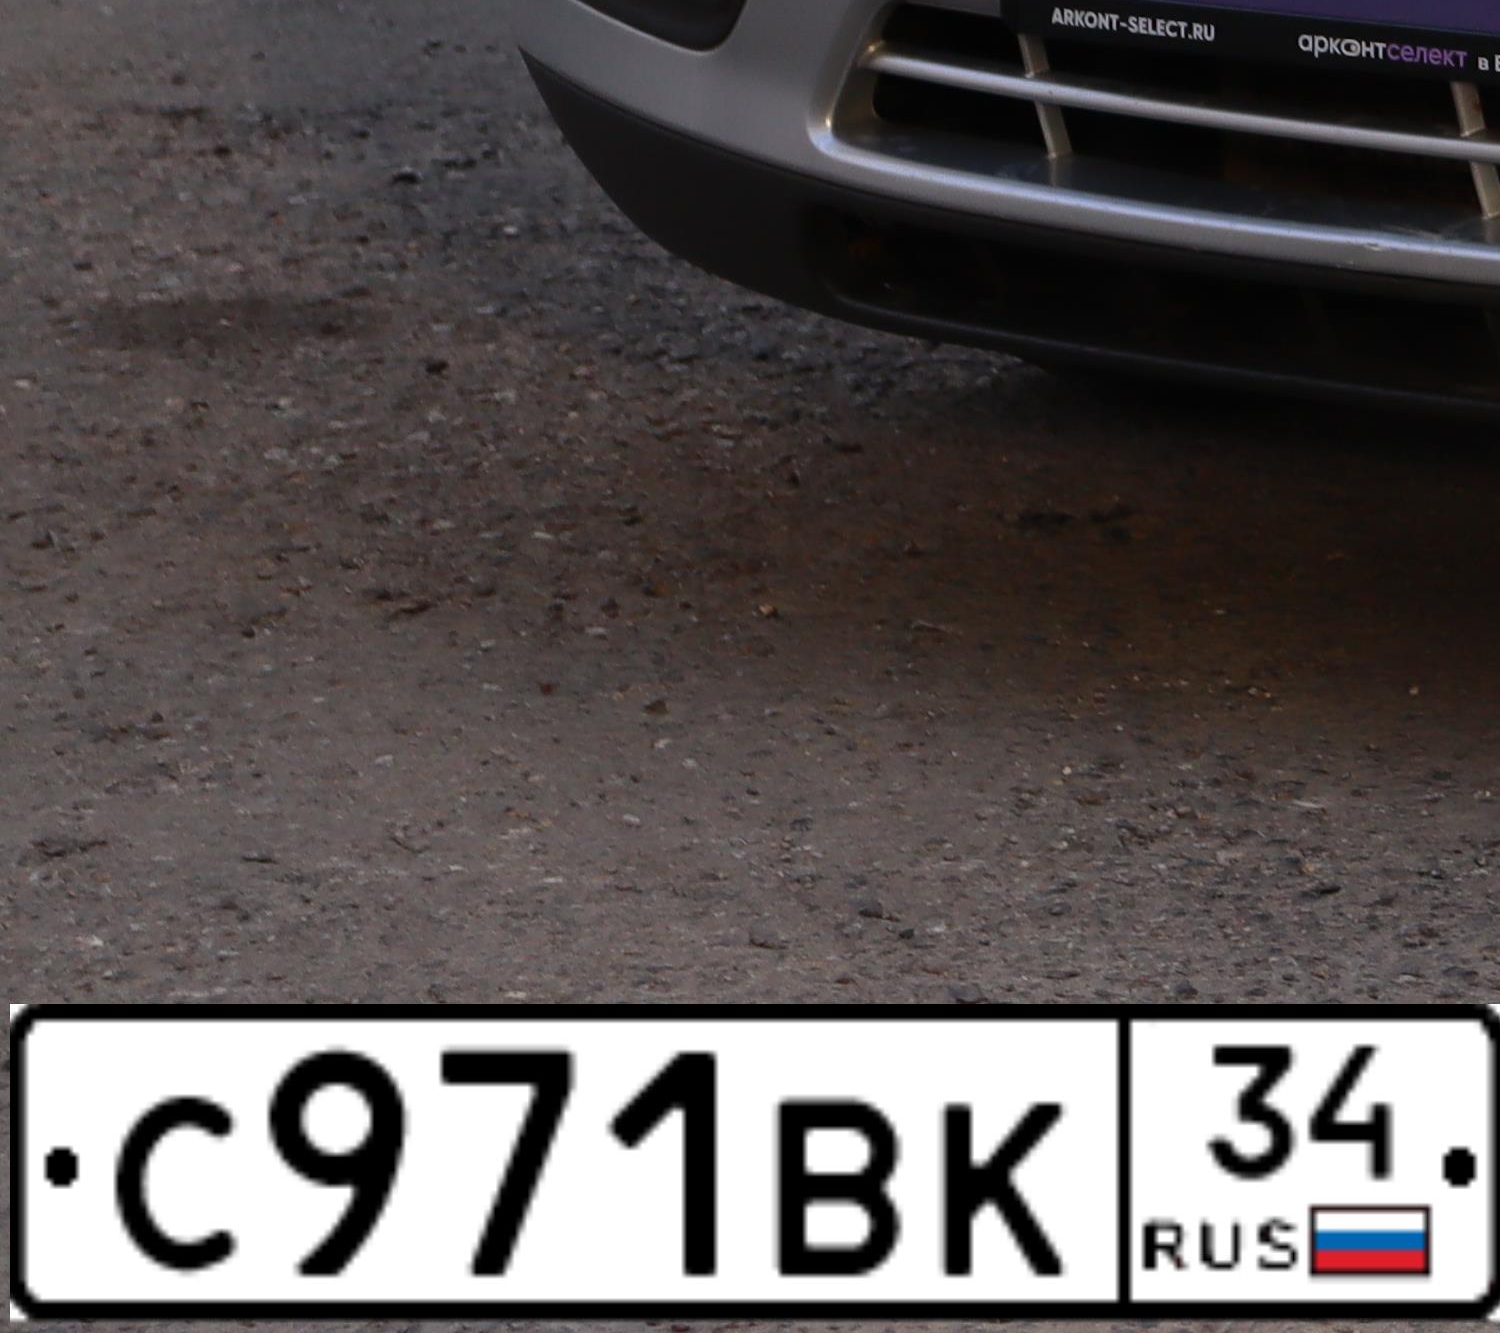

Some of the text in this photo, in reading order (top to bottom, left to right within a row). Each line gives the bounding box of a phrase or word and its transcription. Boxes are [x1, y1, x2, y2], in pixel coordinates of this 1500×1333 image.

[1051, 7, 1215, 41] ARKONT-SELECT.RU
[1298, 33, 1467, 68] арконтселект
[1477, 55, 1489, 71] в
